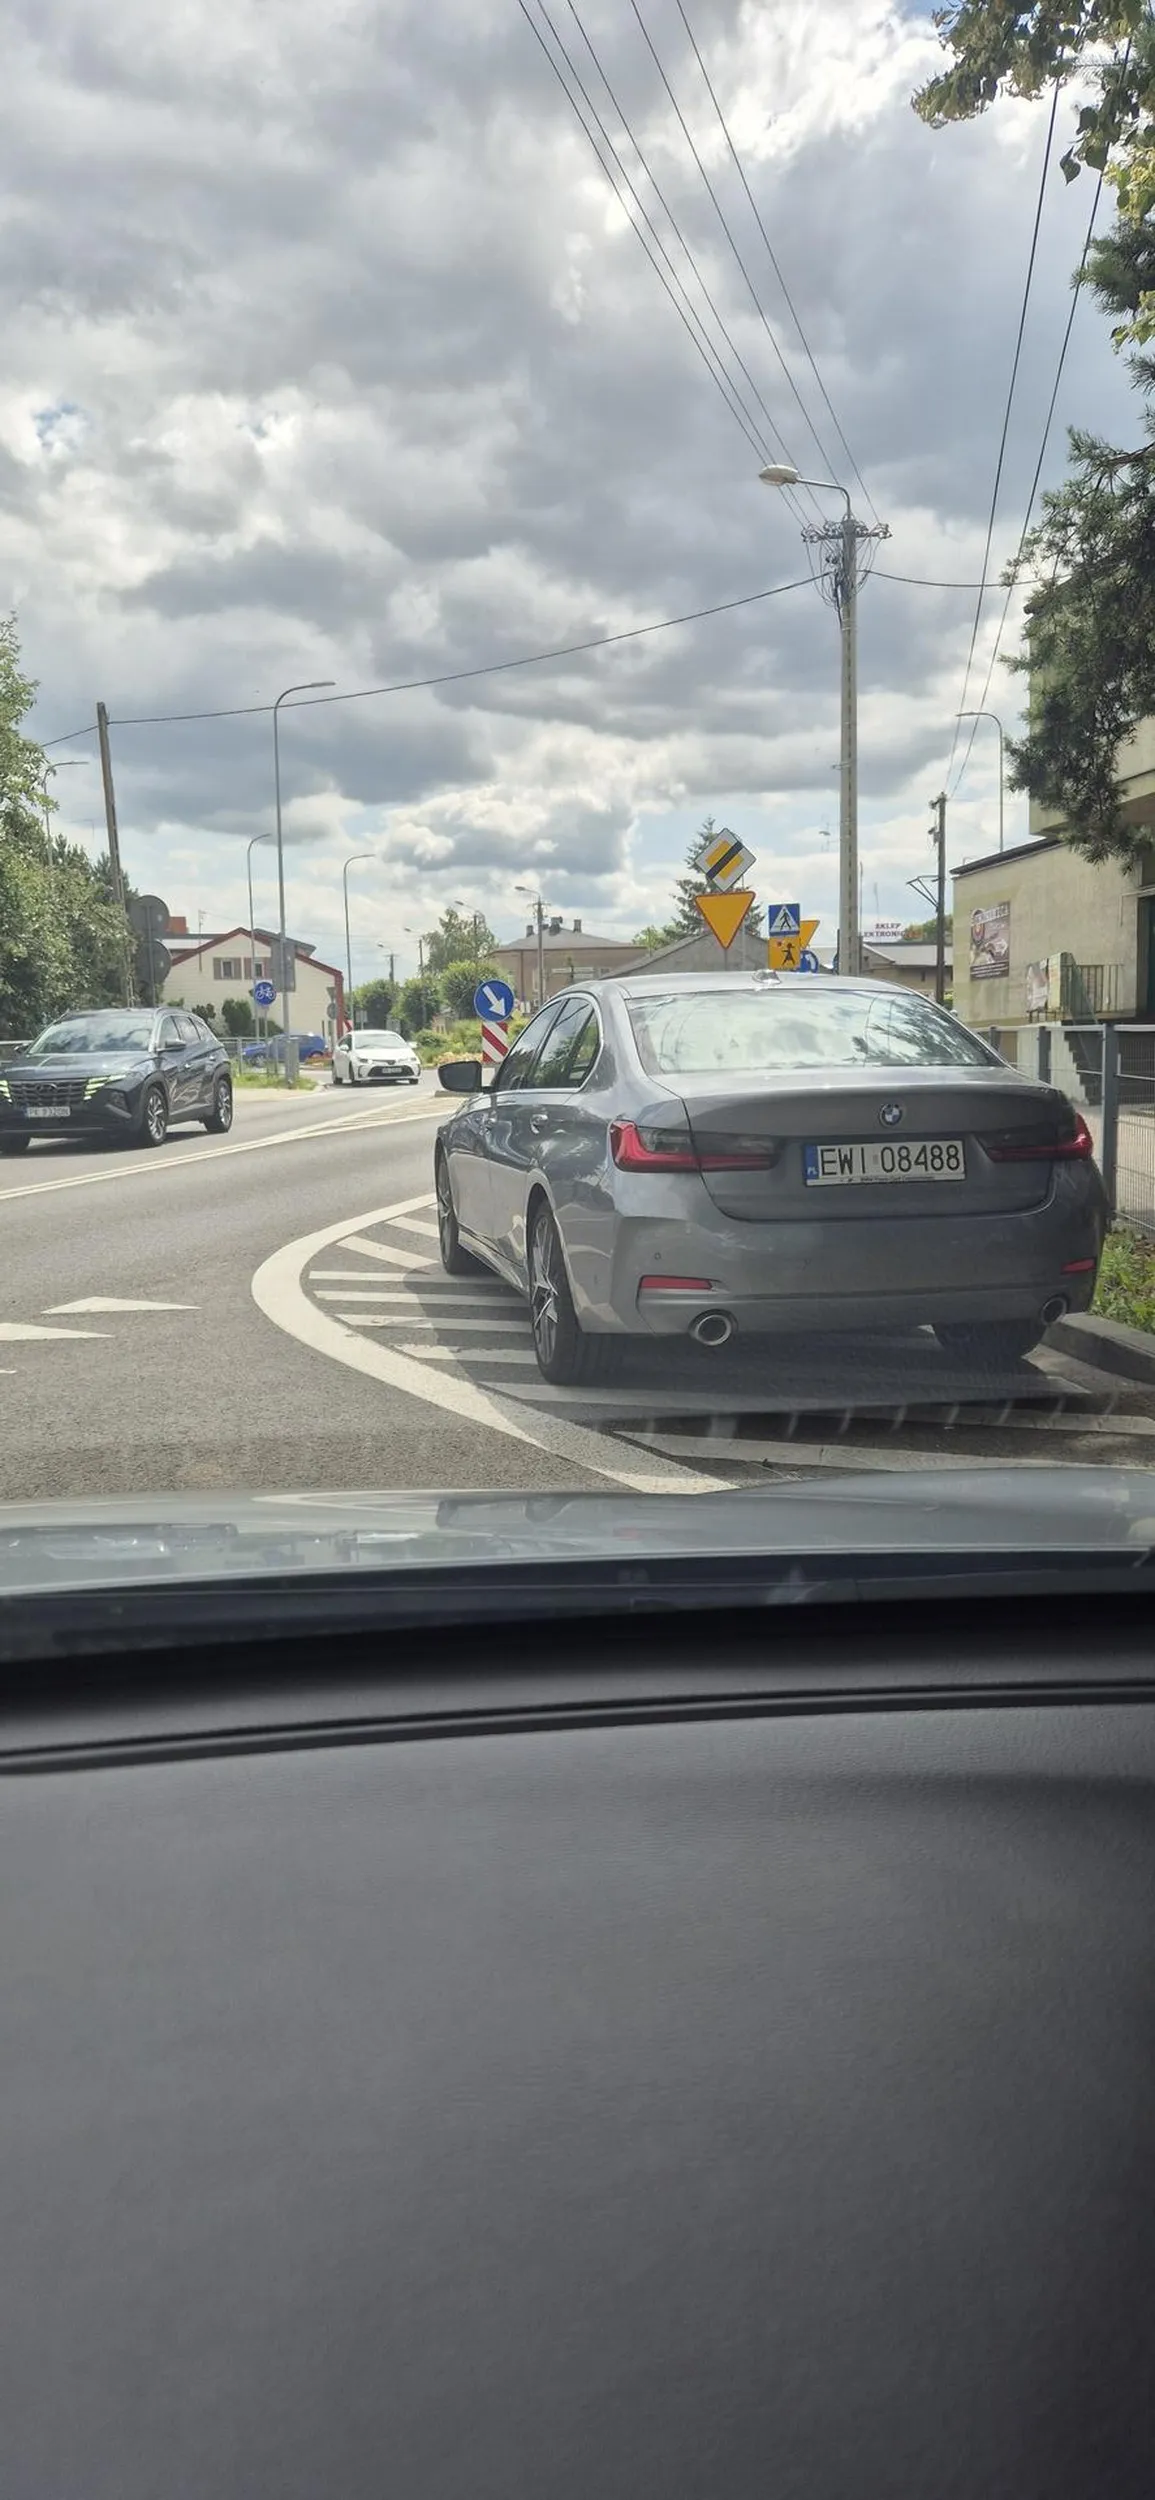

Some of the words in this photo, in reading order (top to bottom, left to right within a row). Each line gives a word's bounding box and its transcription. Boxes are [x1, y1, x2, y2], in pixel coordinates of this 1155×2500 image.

[820, 1147, 866, 1176] EWI
[880, 1144, 960, 1173] 08488
[806, 1167, 818, 1175] PL
